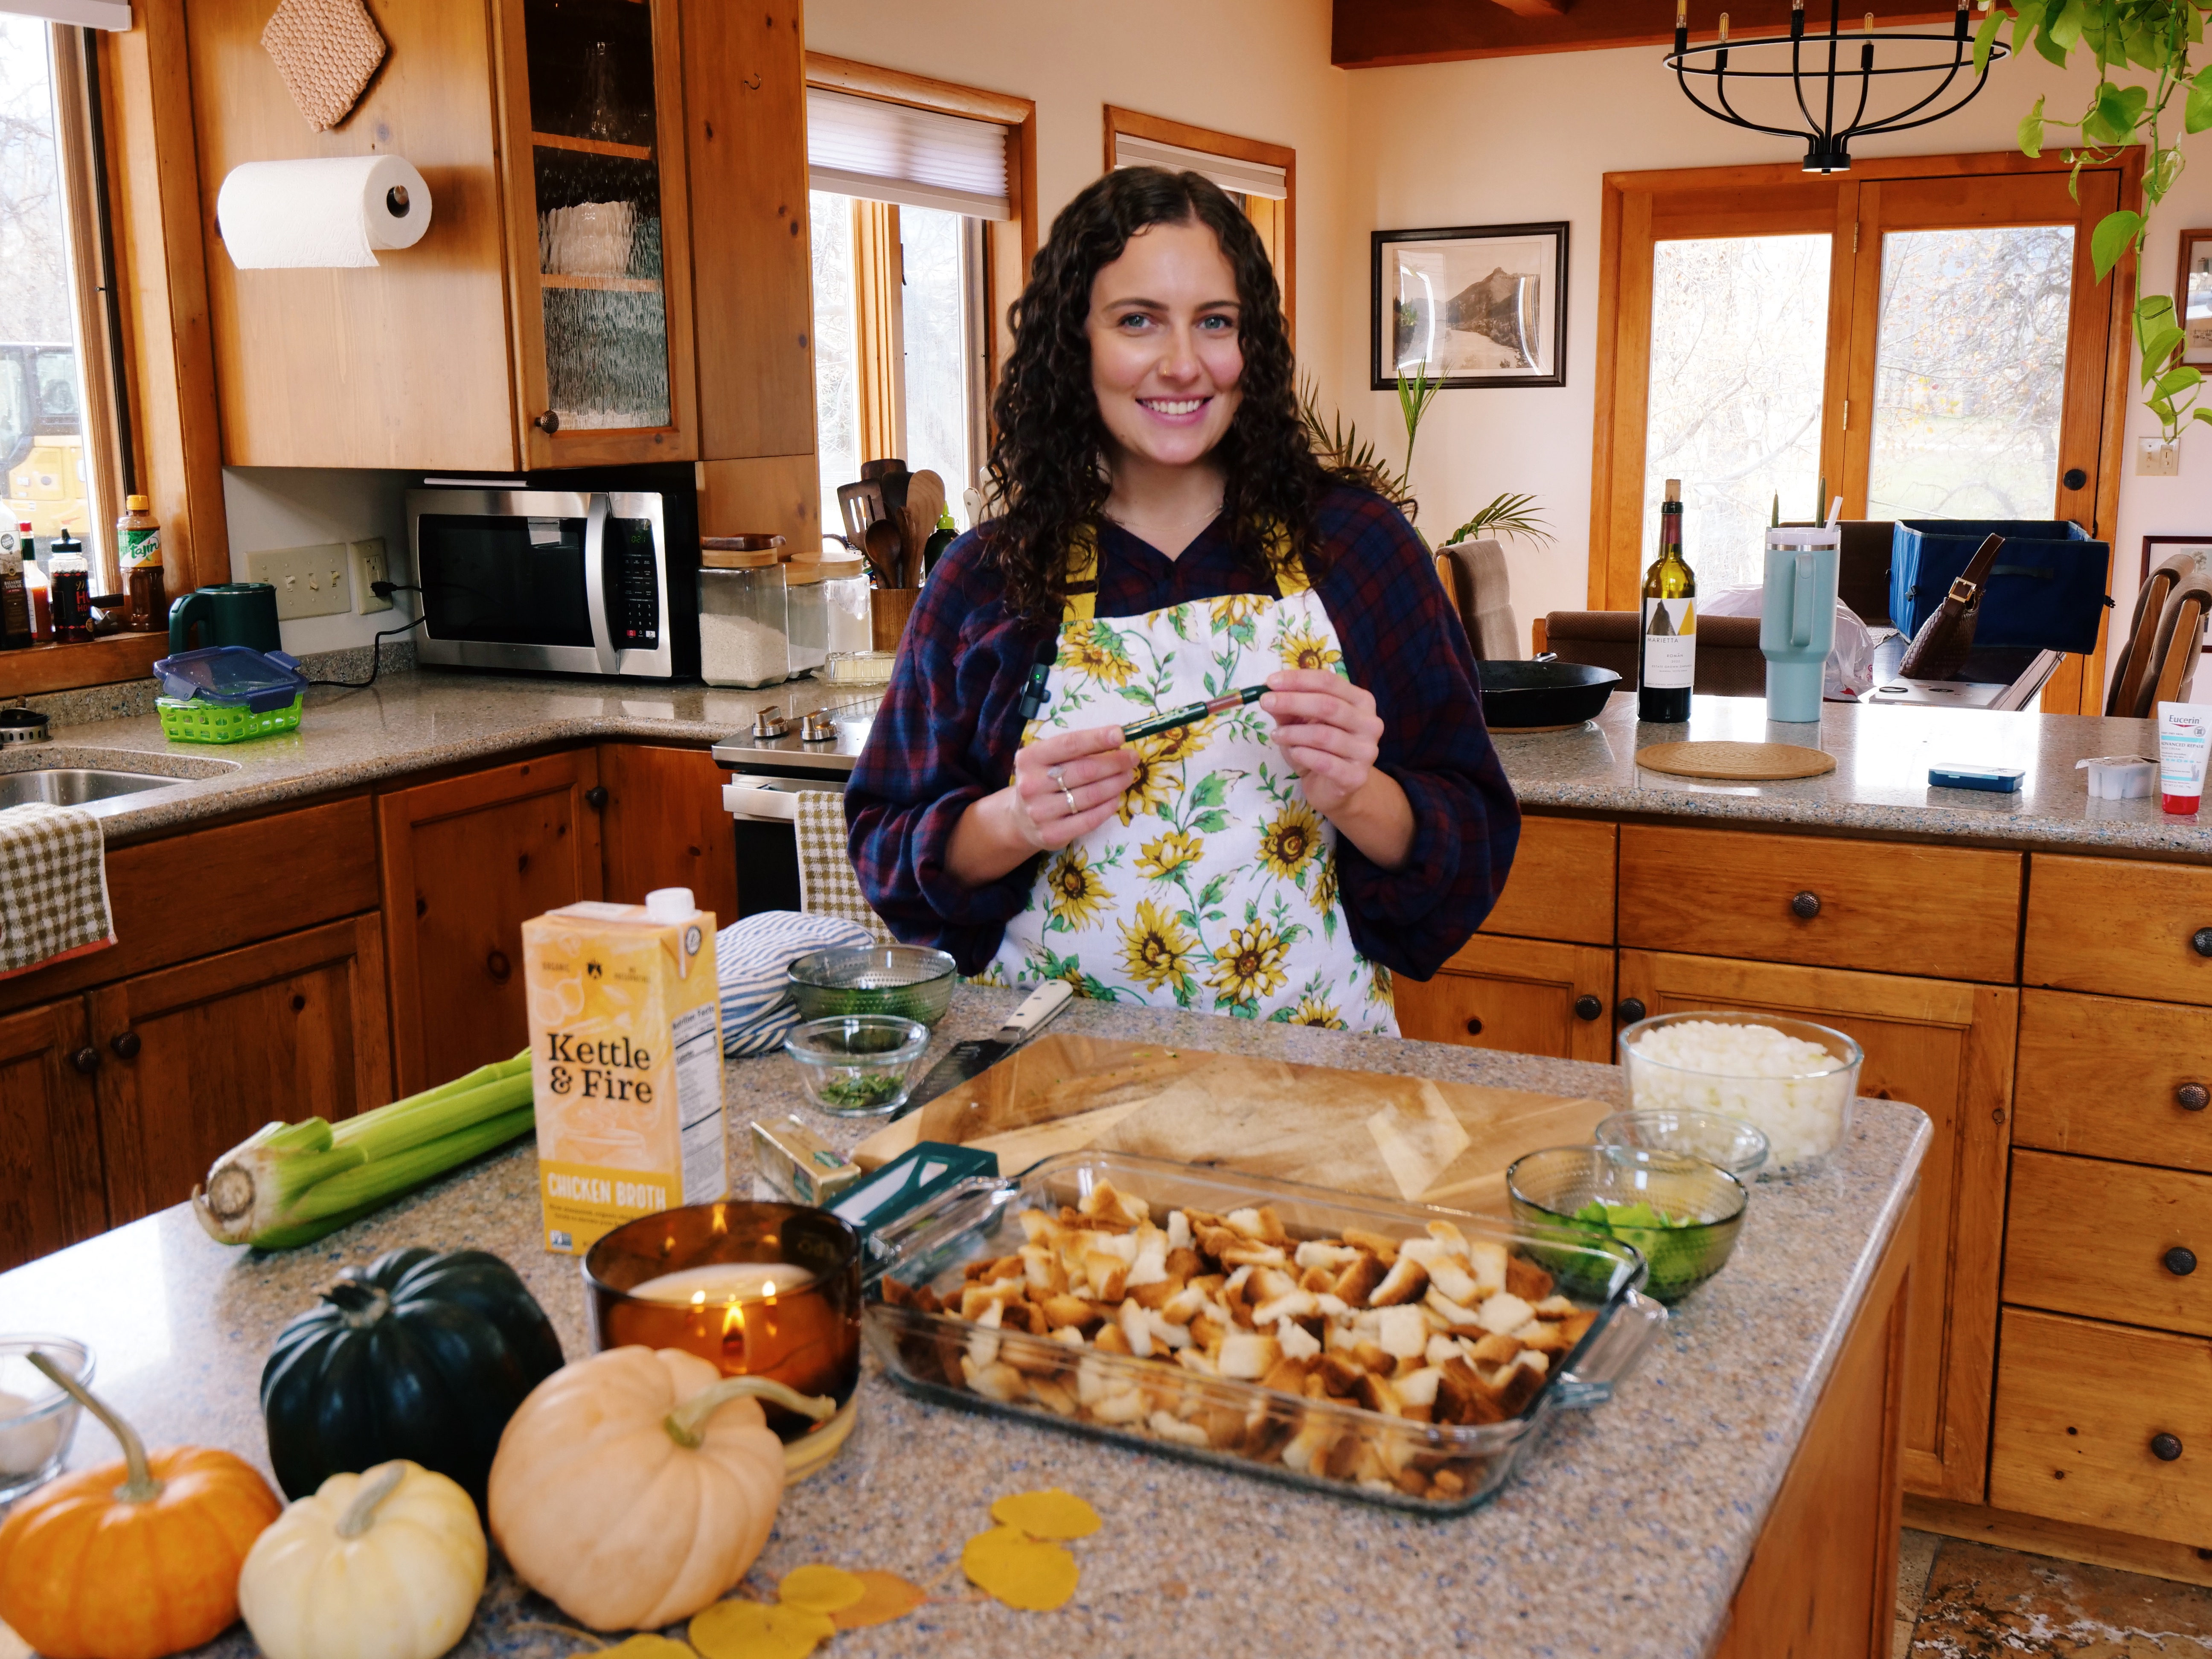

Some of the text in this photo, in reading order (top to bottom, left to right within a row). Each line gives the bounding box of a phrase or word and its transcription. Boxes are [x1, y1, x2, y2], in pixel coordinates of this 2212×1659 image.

[2169, 715, 2200, 724] Eucerin
[547, 1033, 650, 1071] Kettle
[550, 1065, 573, 1095] &
[581, 1068, 653, 1103] Fire
[547, 1172, 611, 1205] CHICKEN
[615, 1180, 667, 1212] BROTH
